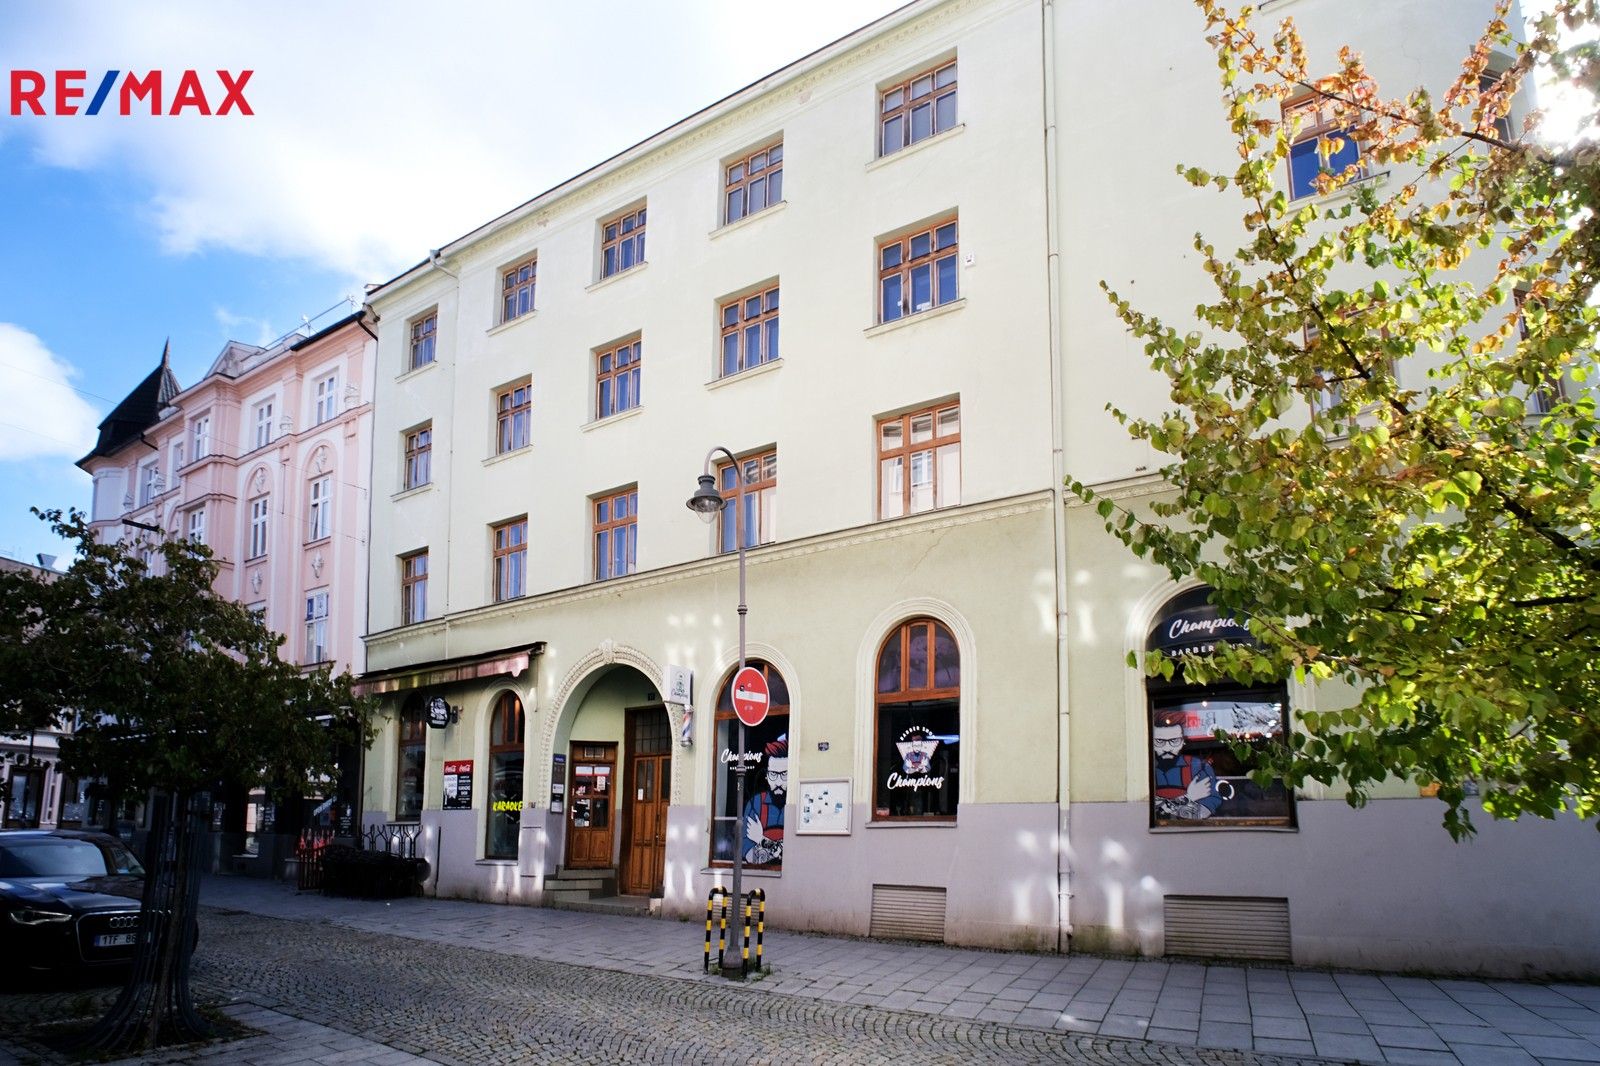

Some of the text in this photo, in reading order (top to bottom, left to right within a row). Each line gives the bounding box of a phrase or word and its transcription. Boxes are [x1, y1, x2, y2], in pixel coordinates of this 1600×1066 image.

[1171, 645, 1215, 656] BARBER
[886, 772, 944, 792] Champions
[493, 800, 523, 812] KARAOKE
